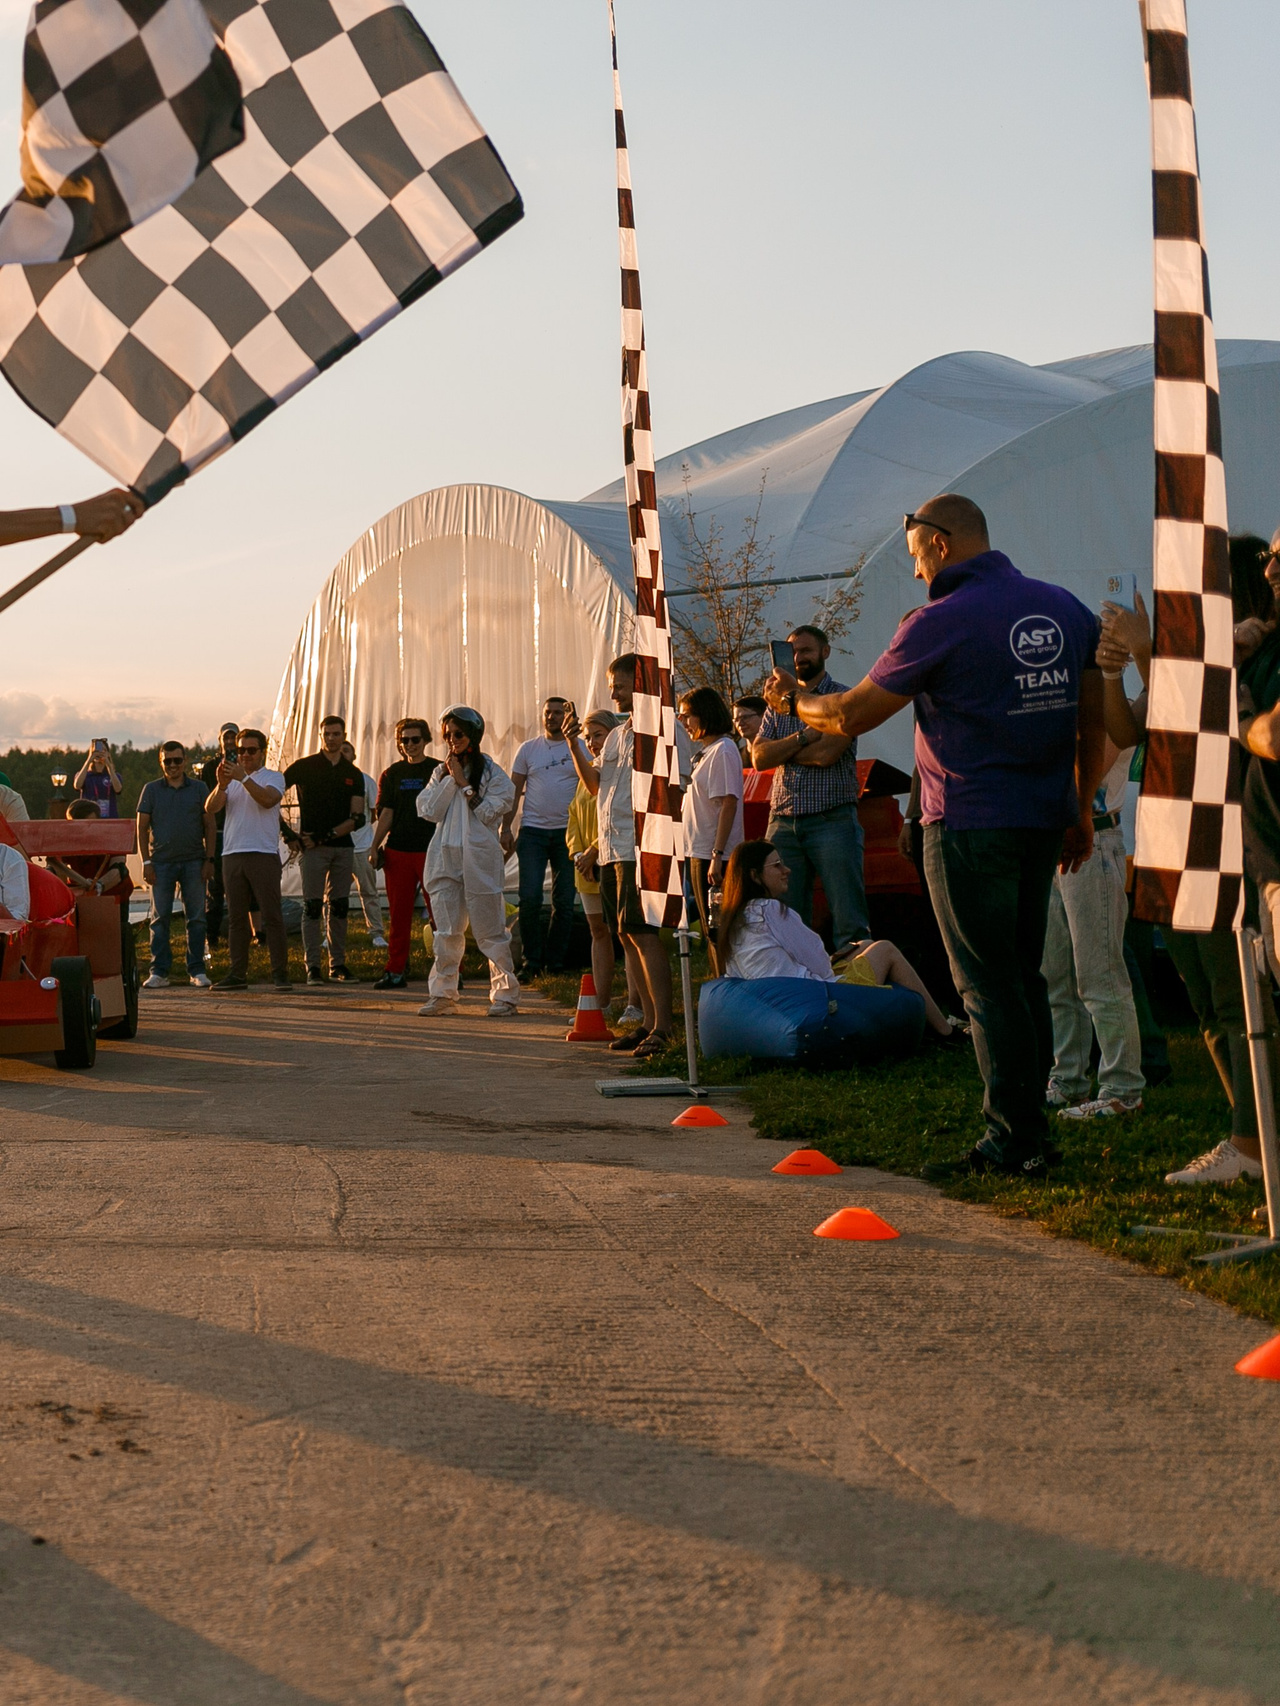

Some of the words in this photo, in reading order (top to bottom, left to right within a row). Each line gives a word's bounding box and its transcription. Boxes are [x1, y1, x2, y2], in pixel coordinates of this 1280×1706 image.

[1017, 627, 1056, 648] AST
[1019, 647, 1037, 656] event
[1037, 645, 1058, 654] group
[1014, 668, 1069, 690] TEAM
